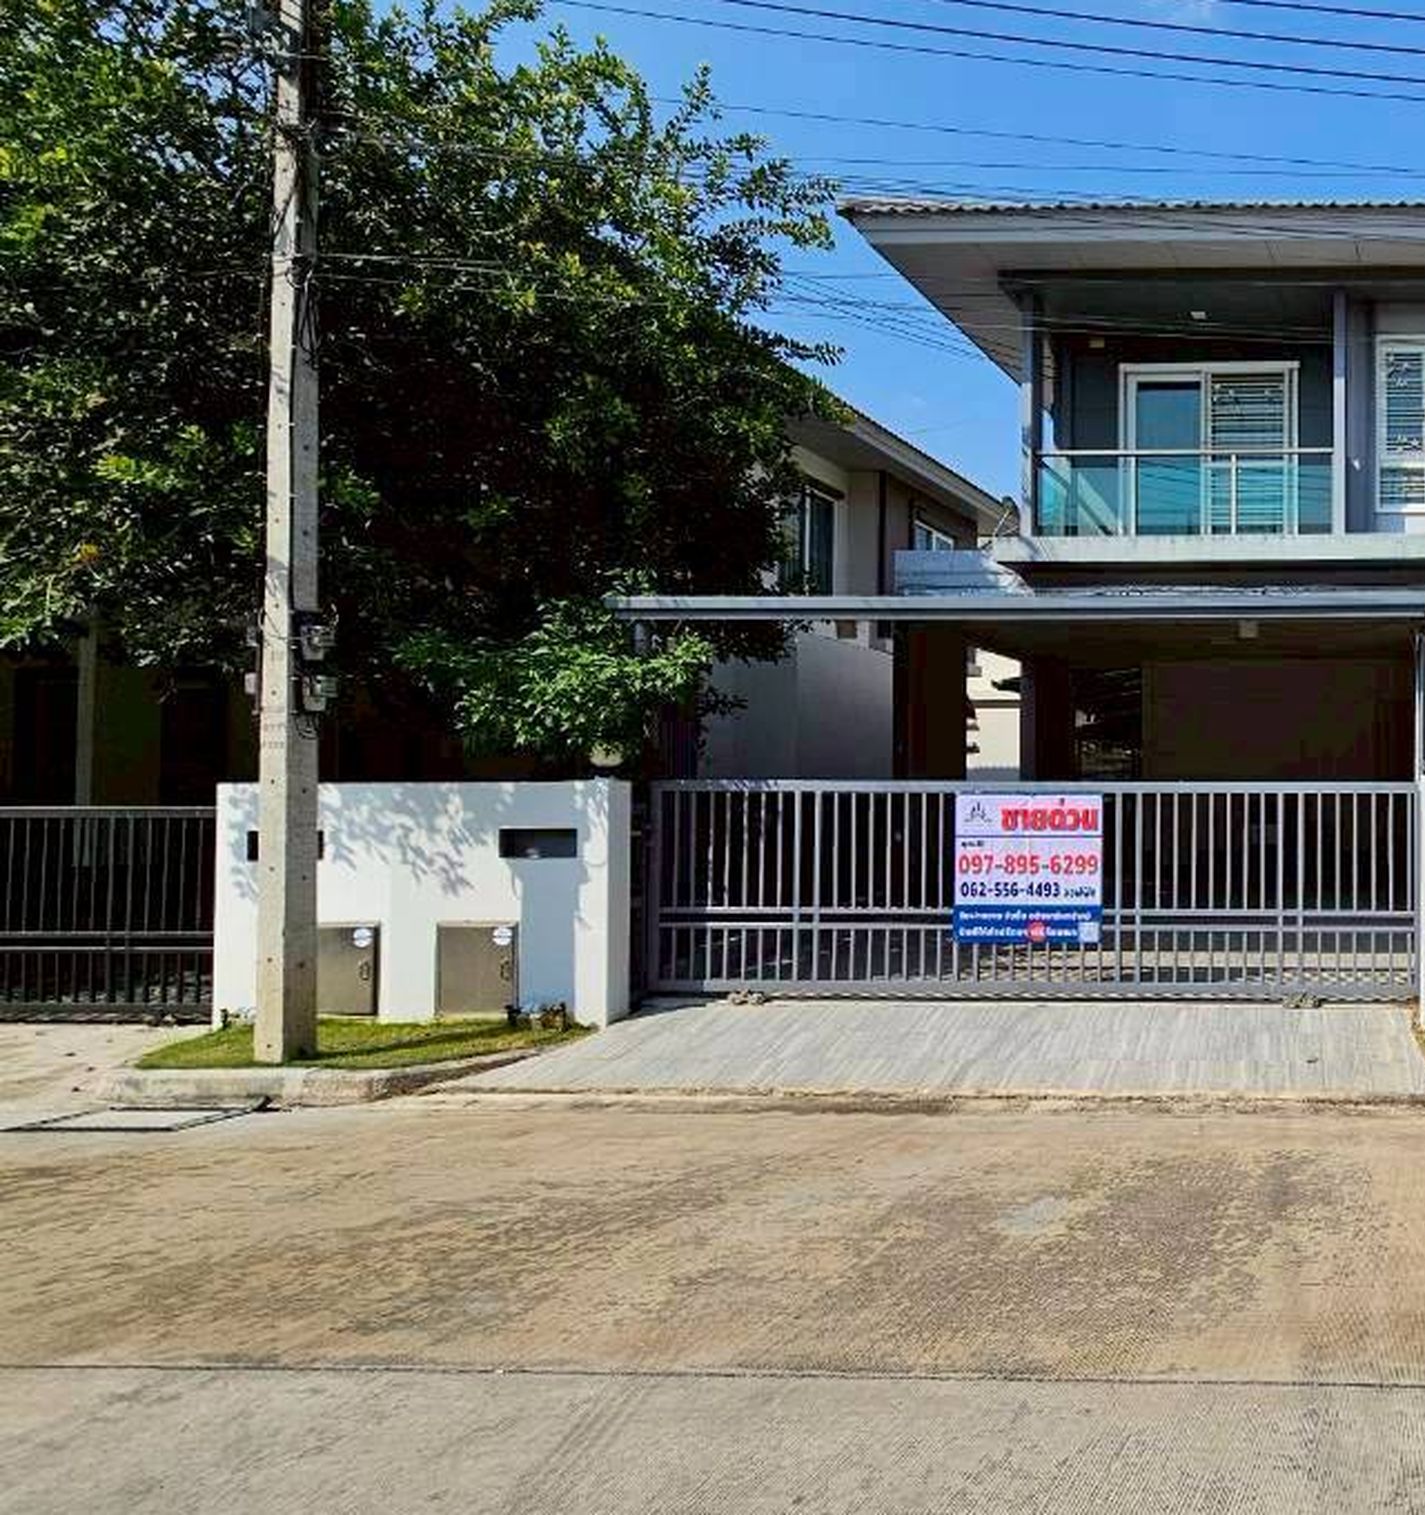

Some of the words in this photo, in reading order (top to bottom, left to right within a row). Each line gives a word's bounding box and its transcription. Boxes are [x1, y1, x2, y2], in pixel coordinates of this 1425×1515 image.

[1001, 798, 1099, 832] ขายด่วน
[958, 854, 1099, 875] 097-895-6299
[960, 881, 1060, 898] 062-556-4493
